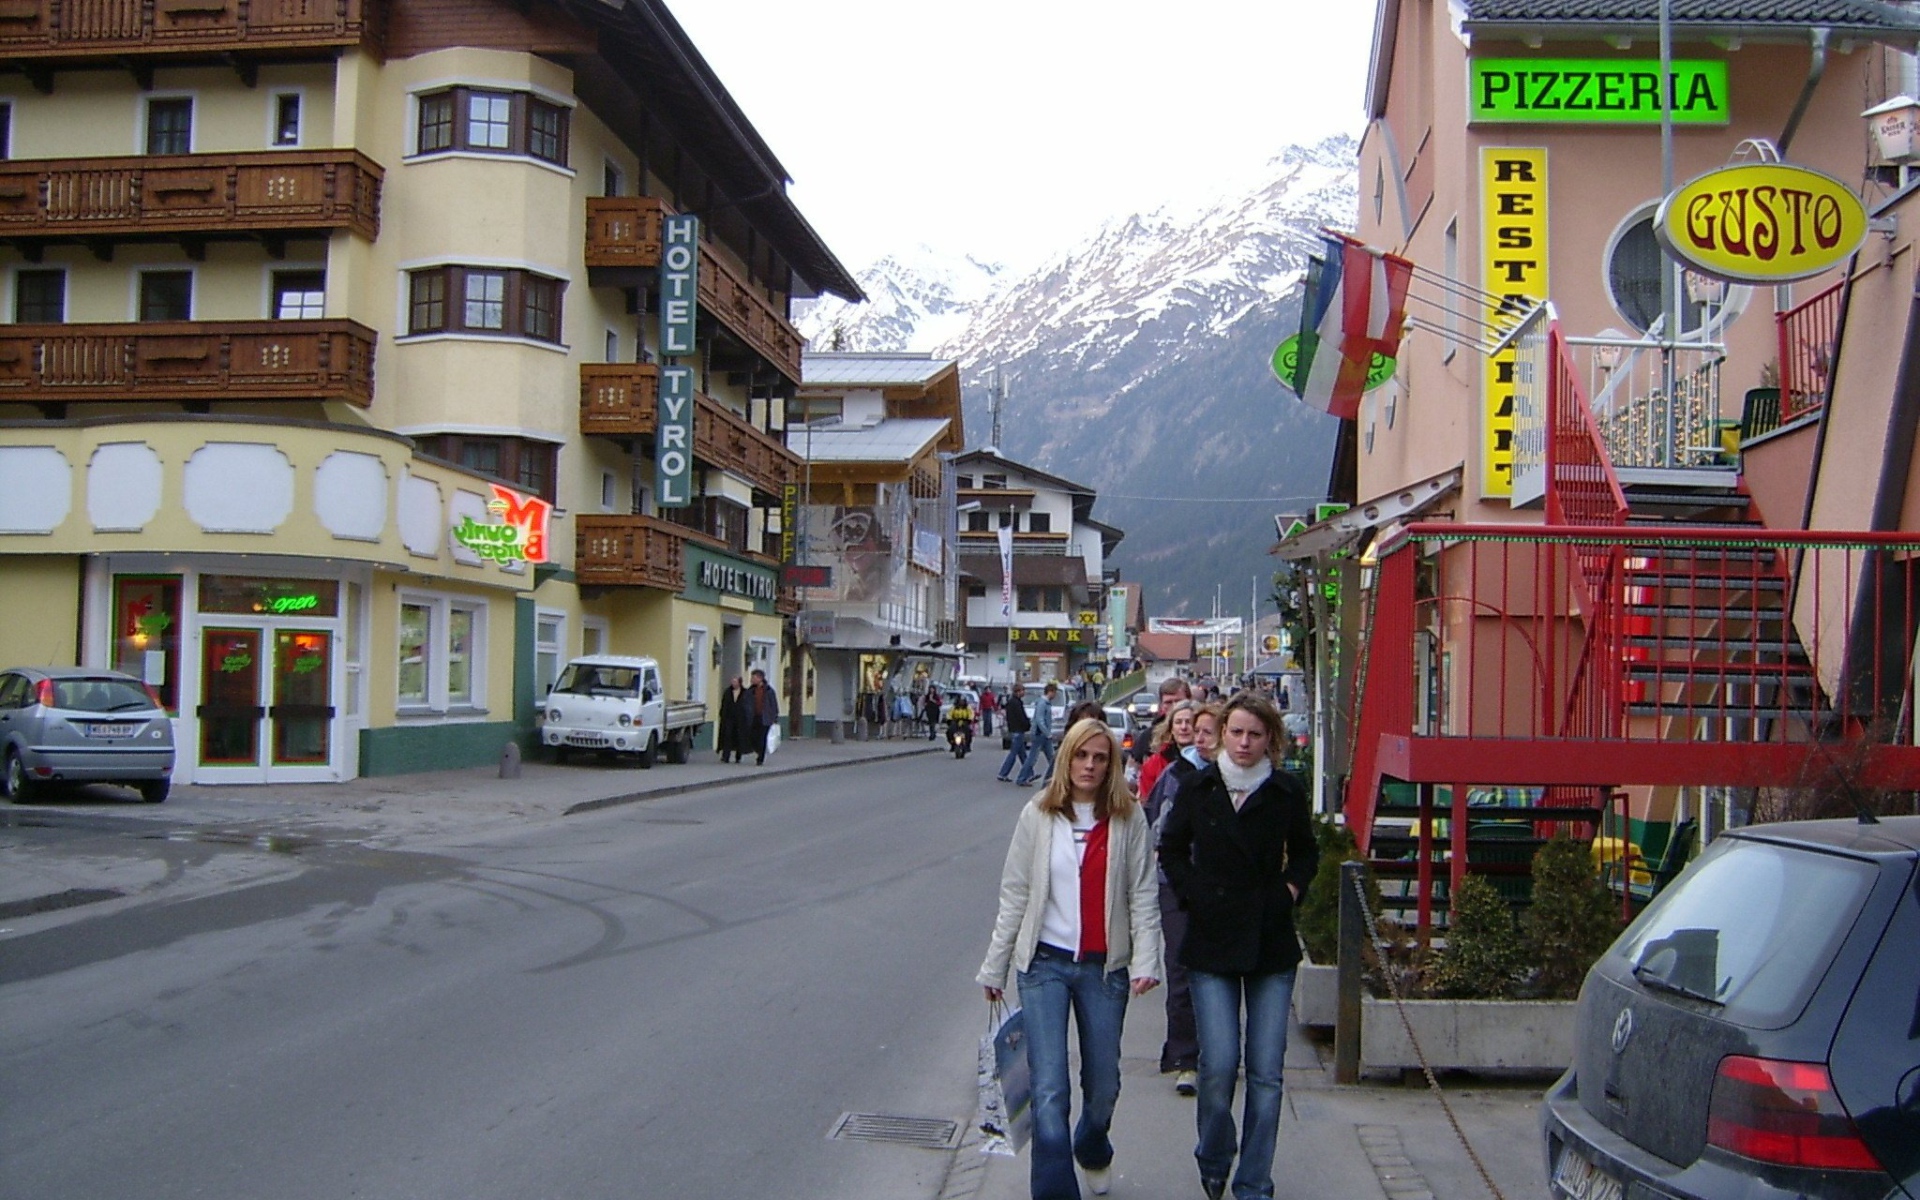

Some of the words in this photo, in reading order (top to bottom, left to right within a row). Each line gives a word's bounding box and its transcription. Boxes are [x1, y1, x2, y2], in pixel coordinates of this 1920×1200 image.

[1480, 71, 1719, 111] PIZZERIA
[1686, 185, 1842, 261] GUSTO
[666, 220, 691, 351] HOTEL
[661, 370, 687, 503] TYROL
[702, 561, 744, 594] HOTEL
[745, 573, 777, 600] TYROL
[274, 595, 317, 612] open
[811, 624, 832, 635] BAR
[1010, 629, 1081, 642] BANK
